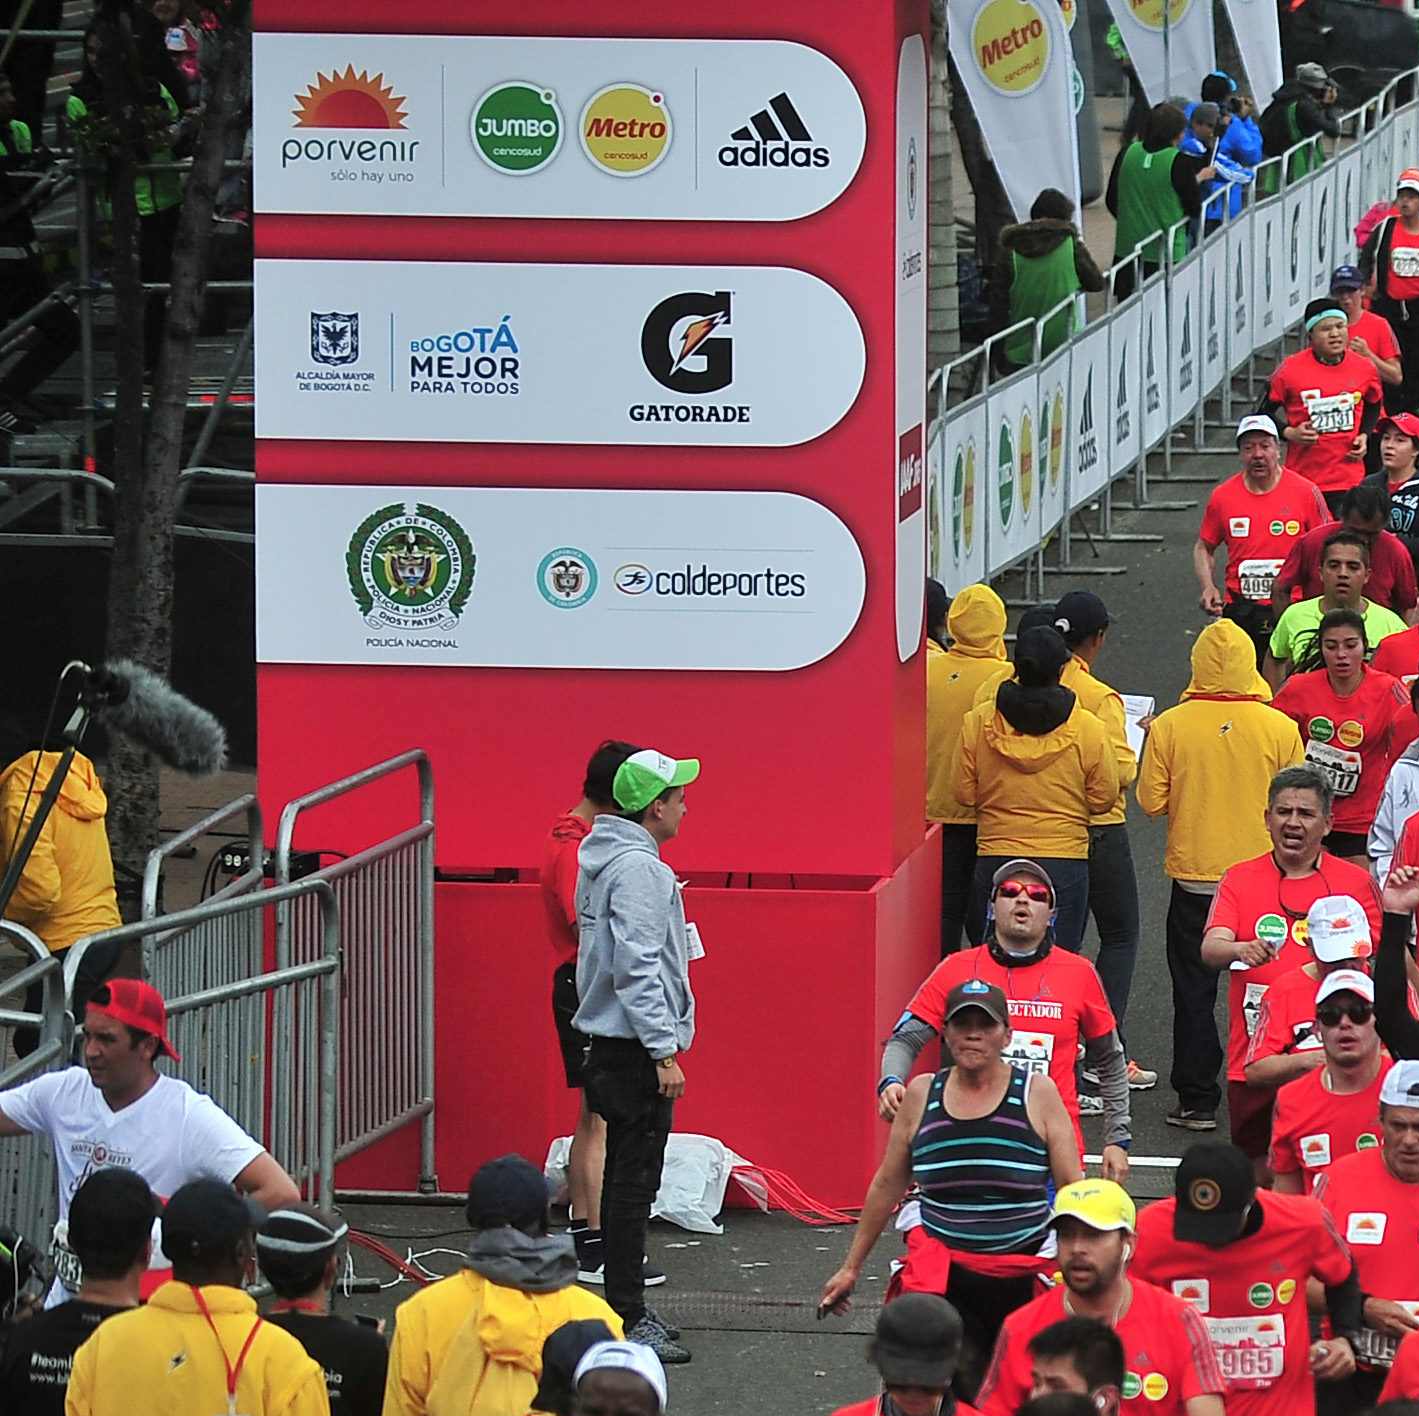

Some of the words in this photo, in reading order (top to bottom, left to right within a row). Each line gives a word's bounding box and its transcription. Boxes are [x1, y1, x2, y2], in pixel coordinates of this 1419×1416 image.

[980, 20, 1044, 64] Metro
[477, 118, 557, 138] JUMBO
[586, 117, 667, 139] Metro
[281, 138, 420, 169] porvenir
[492, 146, 543, 157] cencosud
[603, 151, 649, 161] cencosud
[717, 140, 830, 168] adidas
[331, 169, 358, 183] sólo
[361, 169, 384, 184] hay
[389, 173, 414, 183] uno
[410, 314, 519, 354] BOGOTÁ
[295, 369, 341, 381] ALCALDÍA
[342, 371, 376, 381] MAYOR
[410, 355, 520, 380] MEJOR
[299, 382, 311, 392] DE
[313, 381, 352, 392] BOGOTÁ
[410, 381, 456, 394] PARA
[460, 382, 520, 395] TODOS
[628, 404, 752, 424] GATORADE
[1312, 408, 1355, 433] 27131
[654, 564, 806, 600] coldeportes
[406, 638, 459, 649] NACIONAL
[1007, 1003, 1063, 1021] ECTADOR
[1207, 1320, 1251, 1335] orvenir
